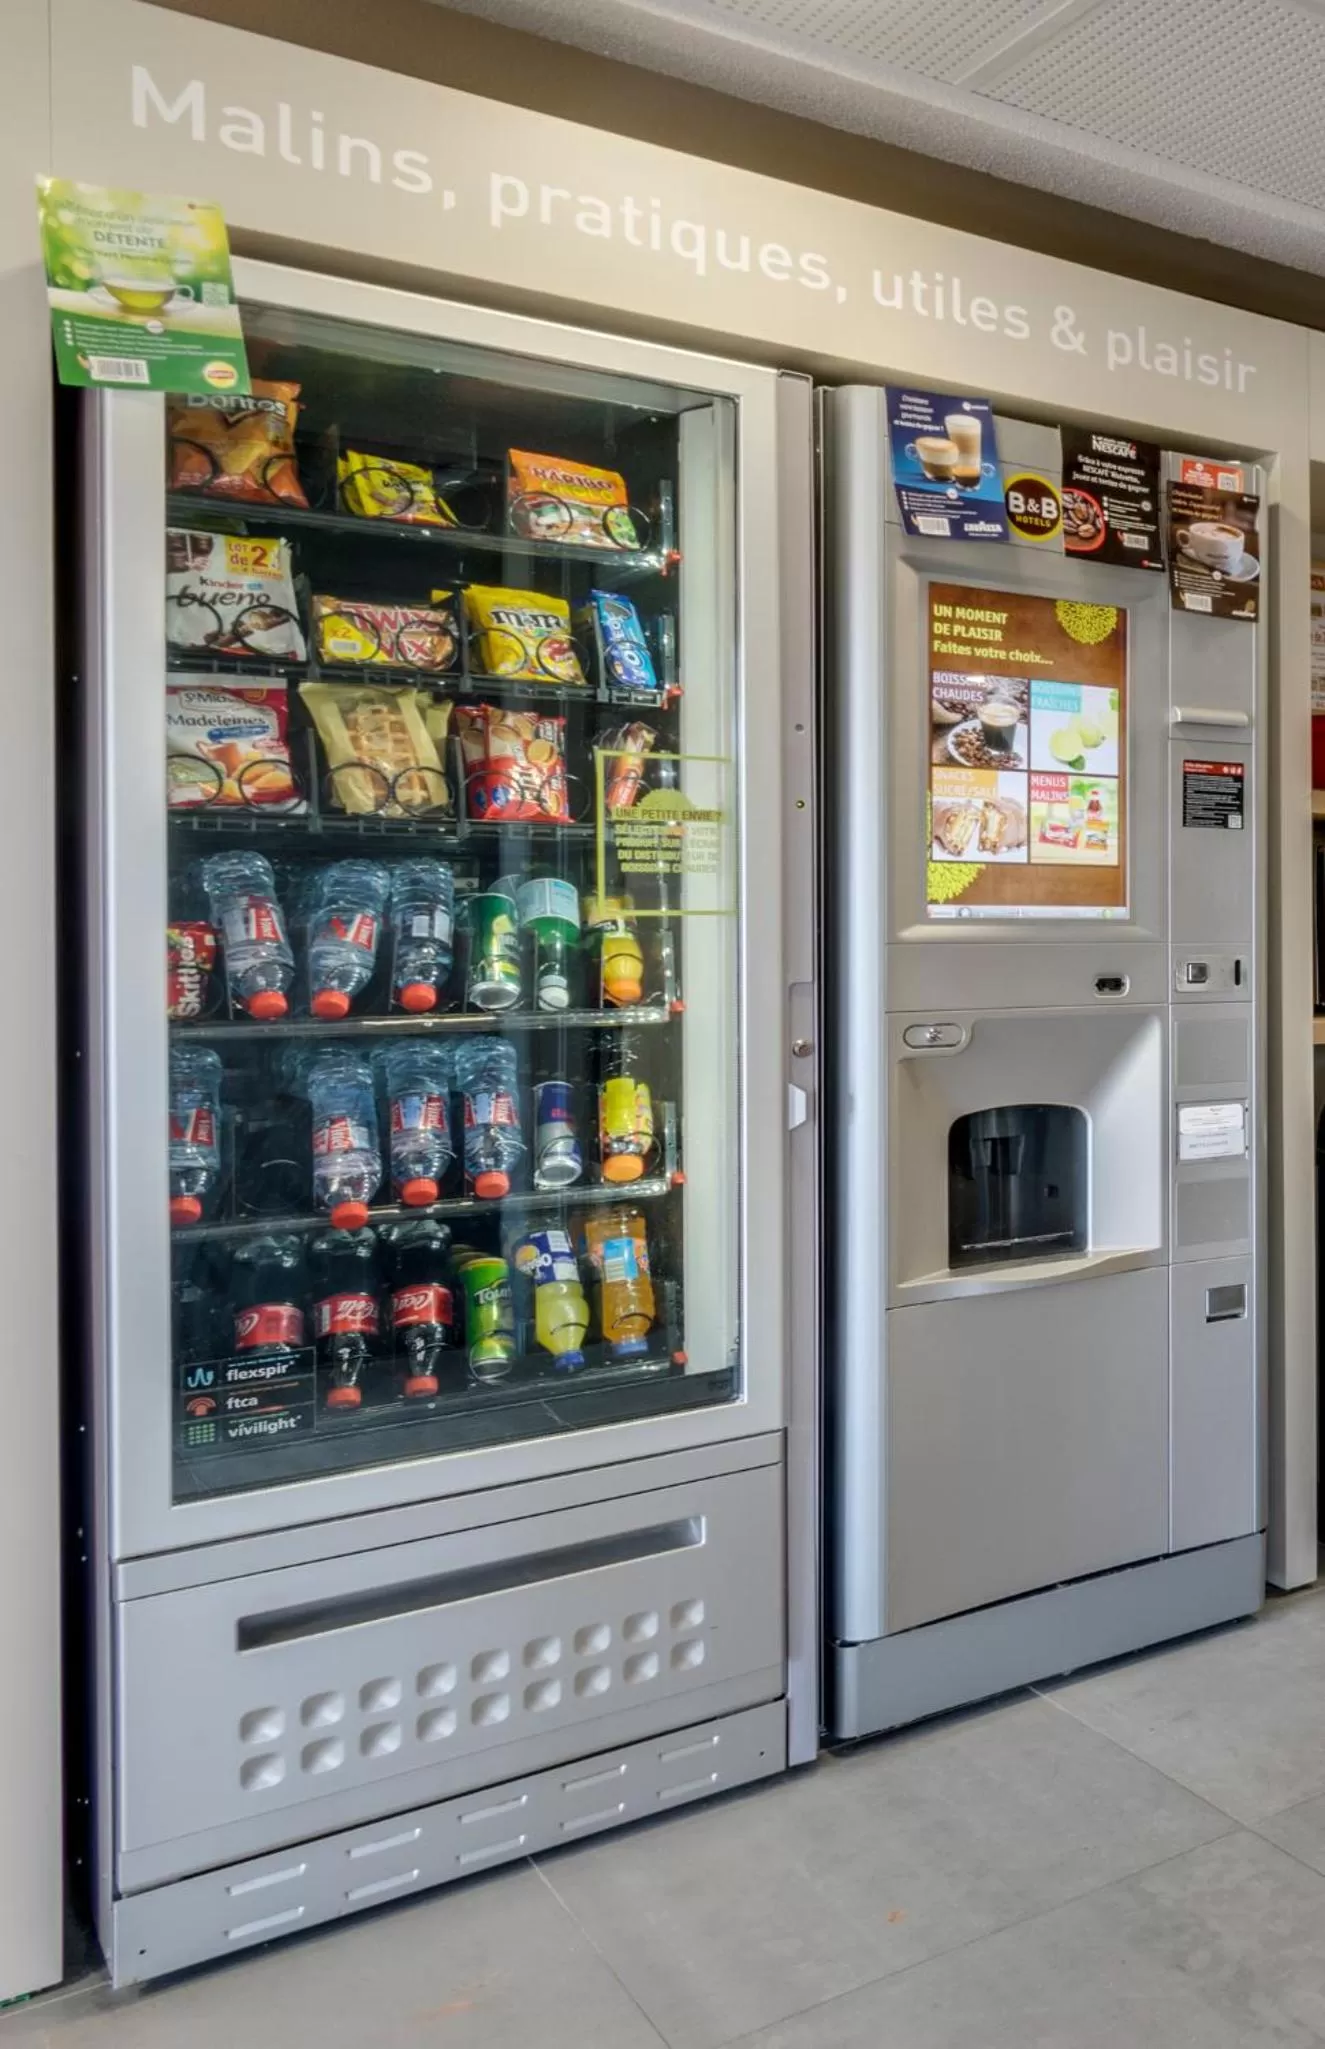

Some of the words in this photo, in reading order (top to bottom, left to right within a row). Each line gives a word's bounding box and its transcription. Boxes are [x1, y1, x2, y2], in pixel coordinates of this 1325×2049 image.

[131, 65, 456, 210] Malins,
[488, 171, 847, 304] pratiques,
[872, 268, 1030, 341] utiles
[1049, 305, 1088, 356] &
[1107, 324, 1258, 393] plaisir
[532, 466, 617, 491] HARIBO
[1008, 491, 1059, 519] B&B
[1015, 515, 1051, 528] HOTELS
[231, 554, 248, 566] de
[251, 546, 268, 568] 2
[176, 584, 271, 608] bueno
[933, 603, 952, 618] UN
[955, 607, 1008, 624] MOMENT
[933, 622, 950, 635] DE
[953, 626, 1003, 641] PLAISIR
[933, 640, 972, 656] Faites
[974, 646, 1006, 660] votre
[933, 687, 984, 702] CHAUDES
[167, 714, 267, 727] Madeleines
[1031, 775, 1067, 788] MENUS
[1031, 790, 1069, 802] MALINS
[616, 807, 640, 819] UNE
[641, 808, 680, 820] PETITE
[682, 810, 713, 821] ENVIE
[178, 935, 201, 1018] Skittles
[226, 1397, 259, 1410] ftca
